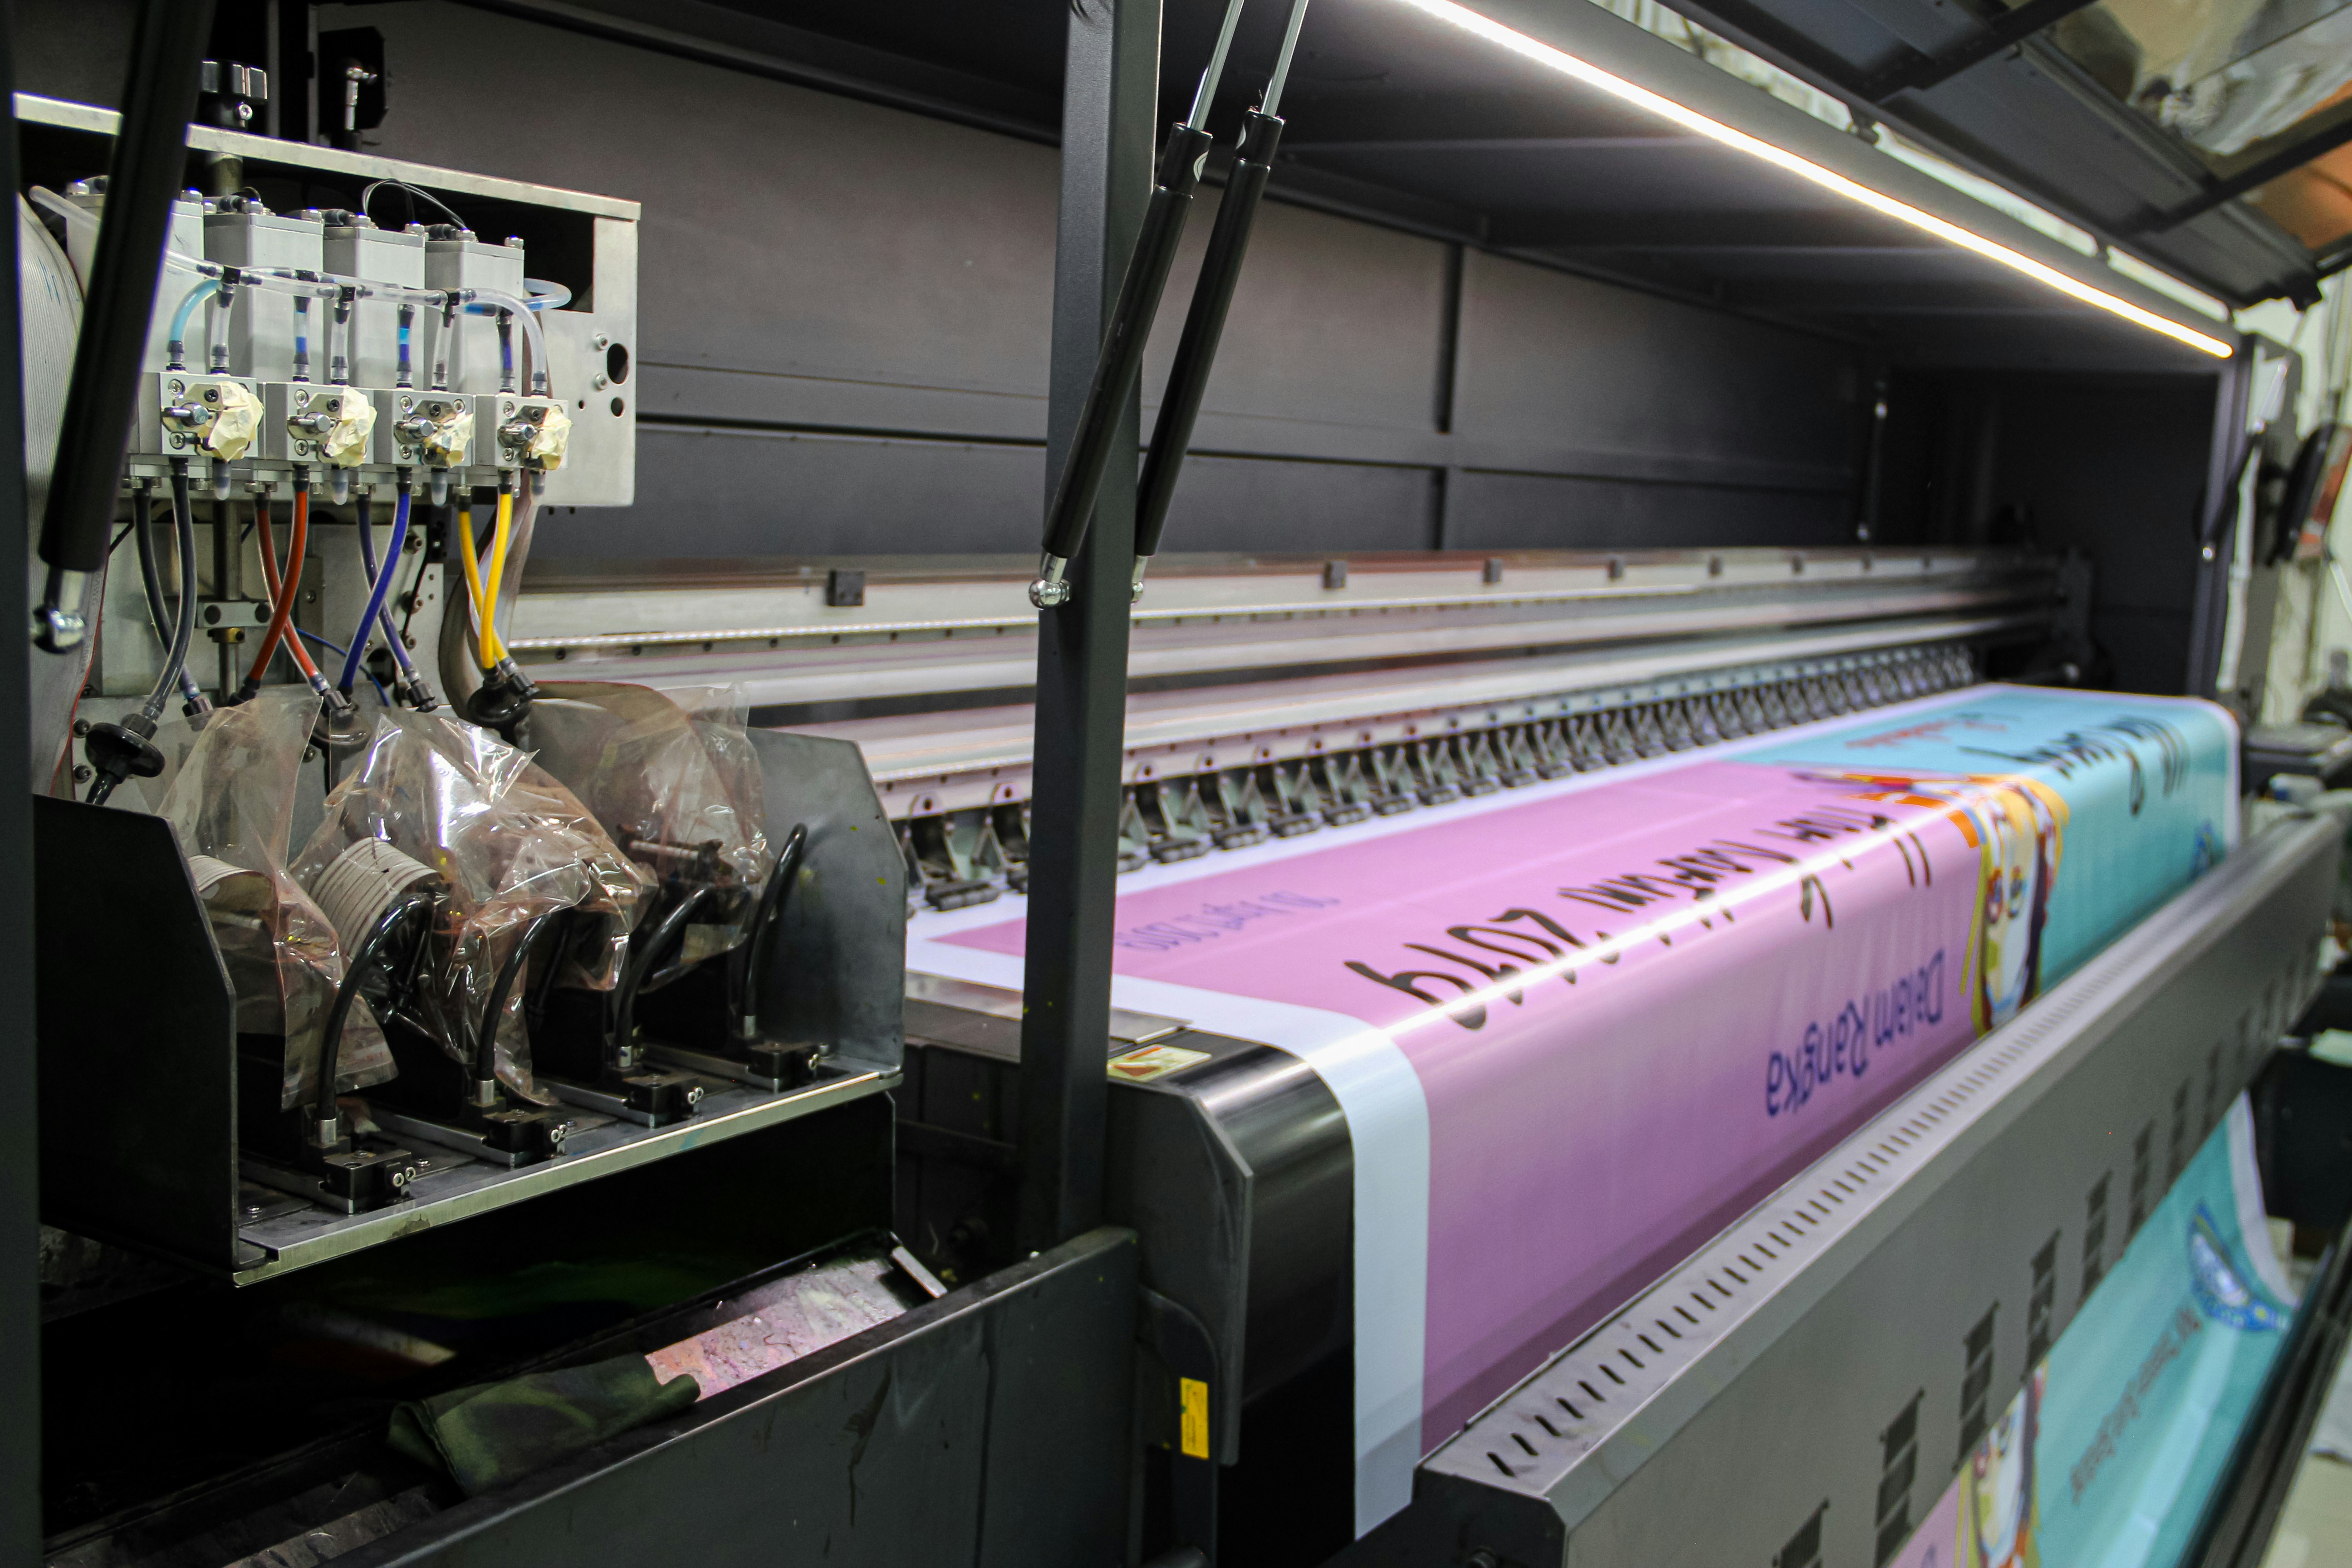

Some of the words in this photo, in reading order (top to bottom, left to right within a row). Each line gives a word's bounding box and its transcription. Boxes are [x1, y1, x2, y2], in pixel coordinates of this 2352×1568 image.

[1343, 908, 1621, 1032] 2019
[1874, 948, 1945, 1048] Dalam
[1766, 995, 1869, 1118] Rangka
